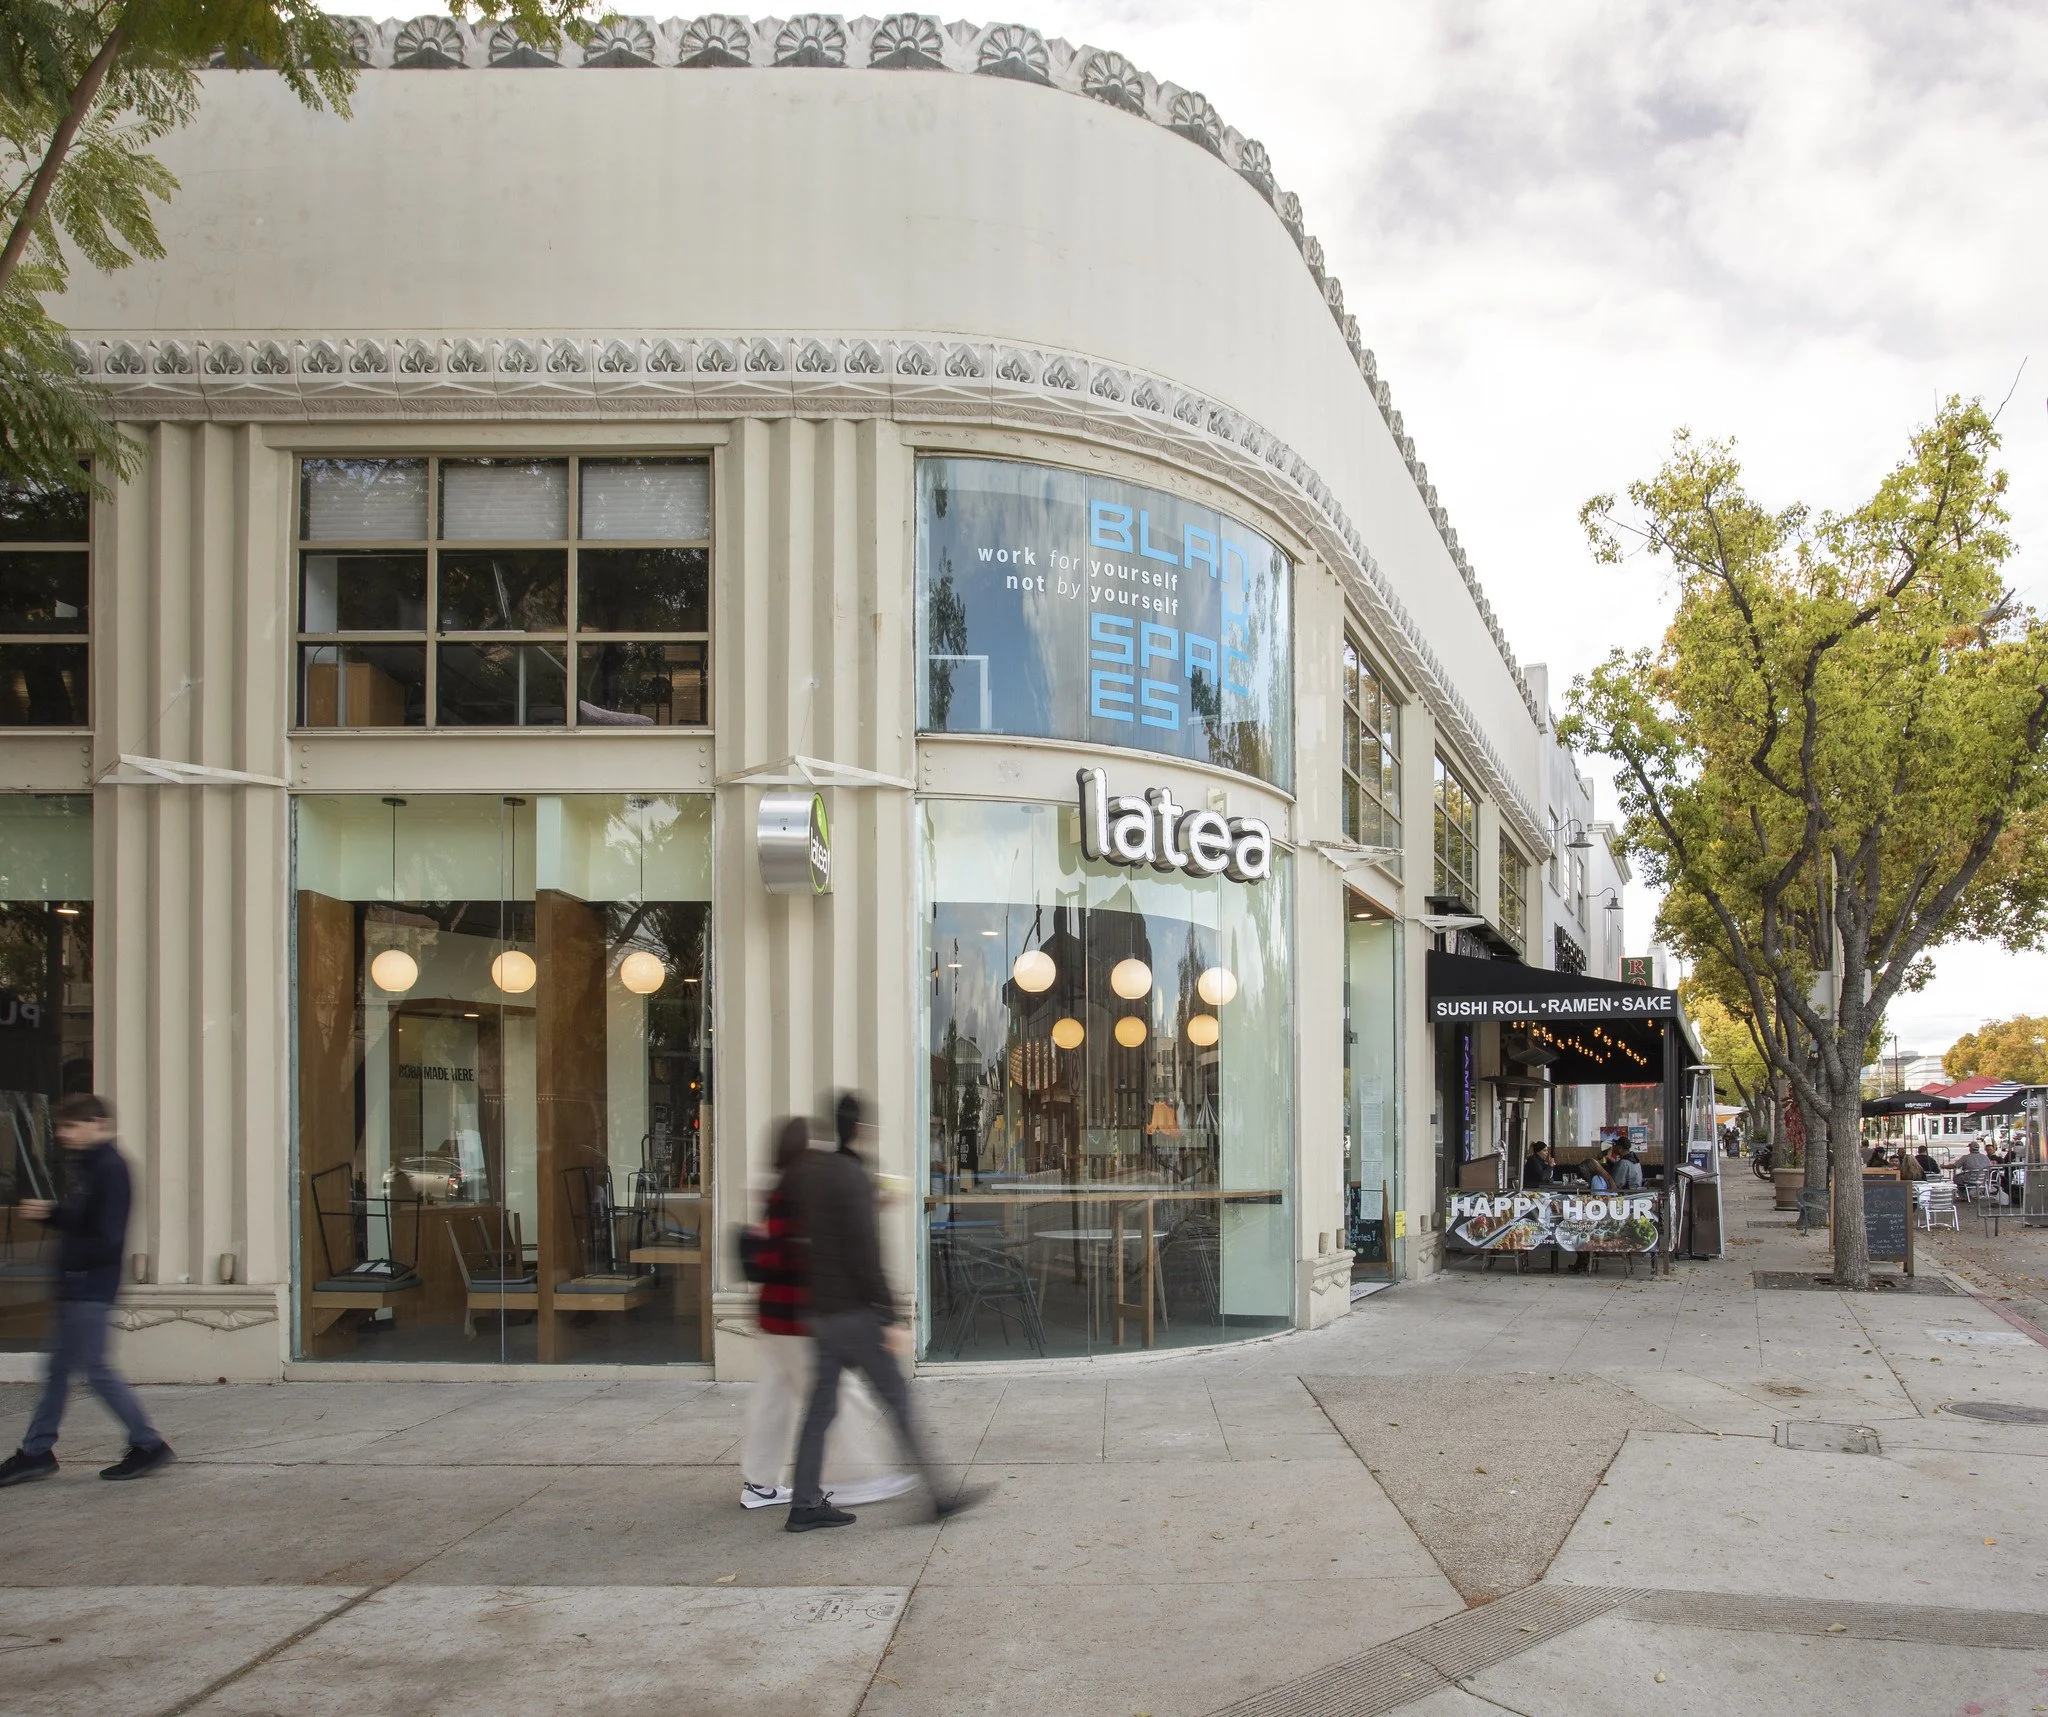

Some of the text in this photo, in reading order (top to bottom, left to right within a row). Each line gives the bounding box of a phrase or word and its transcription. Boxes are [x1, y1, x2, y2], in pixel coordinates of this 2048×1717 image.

[978, 547, 1178, 592] work for yourself
[1006, 575, 1178, 616] not by yourself
[1090, 670, 1179, 731] ES
[1077, 767, 1272, 884] latea
[1437, 996, 1672, 1016] SUSHI ROLL RAMEN SAKE
[423, 1066, 450, 1081] MADE
[451, 1068, 474, 1082] HERE
[1451, 1196, 1655, 1220] HAPPY HOUR
